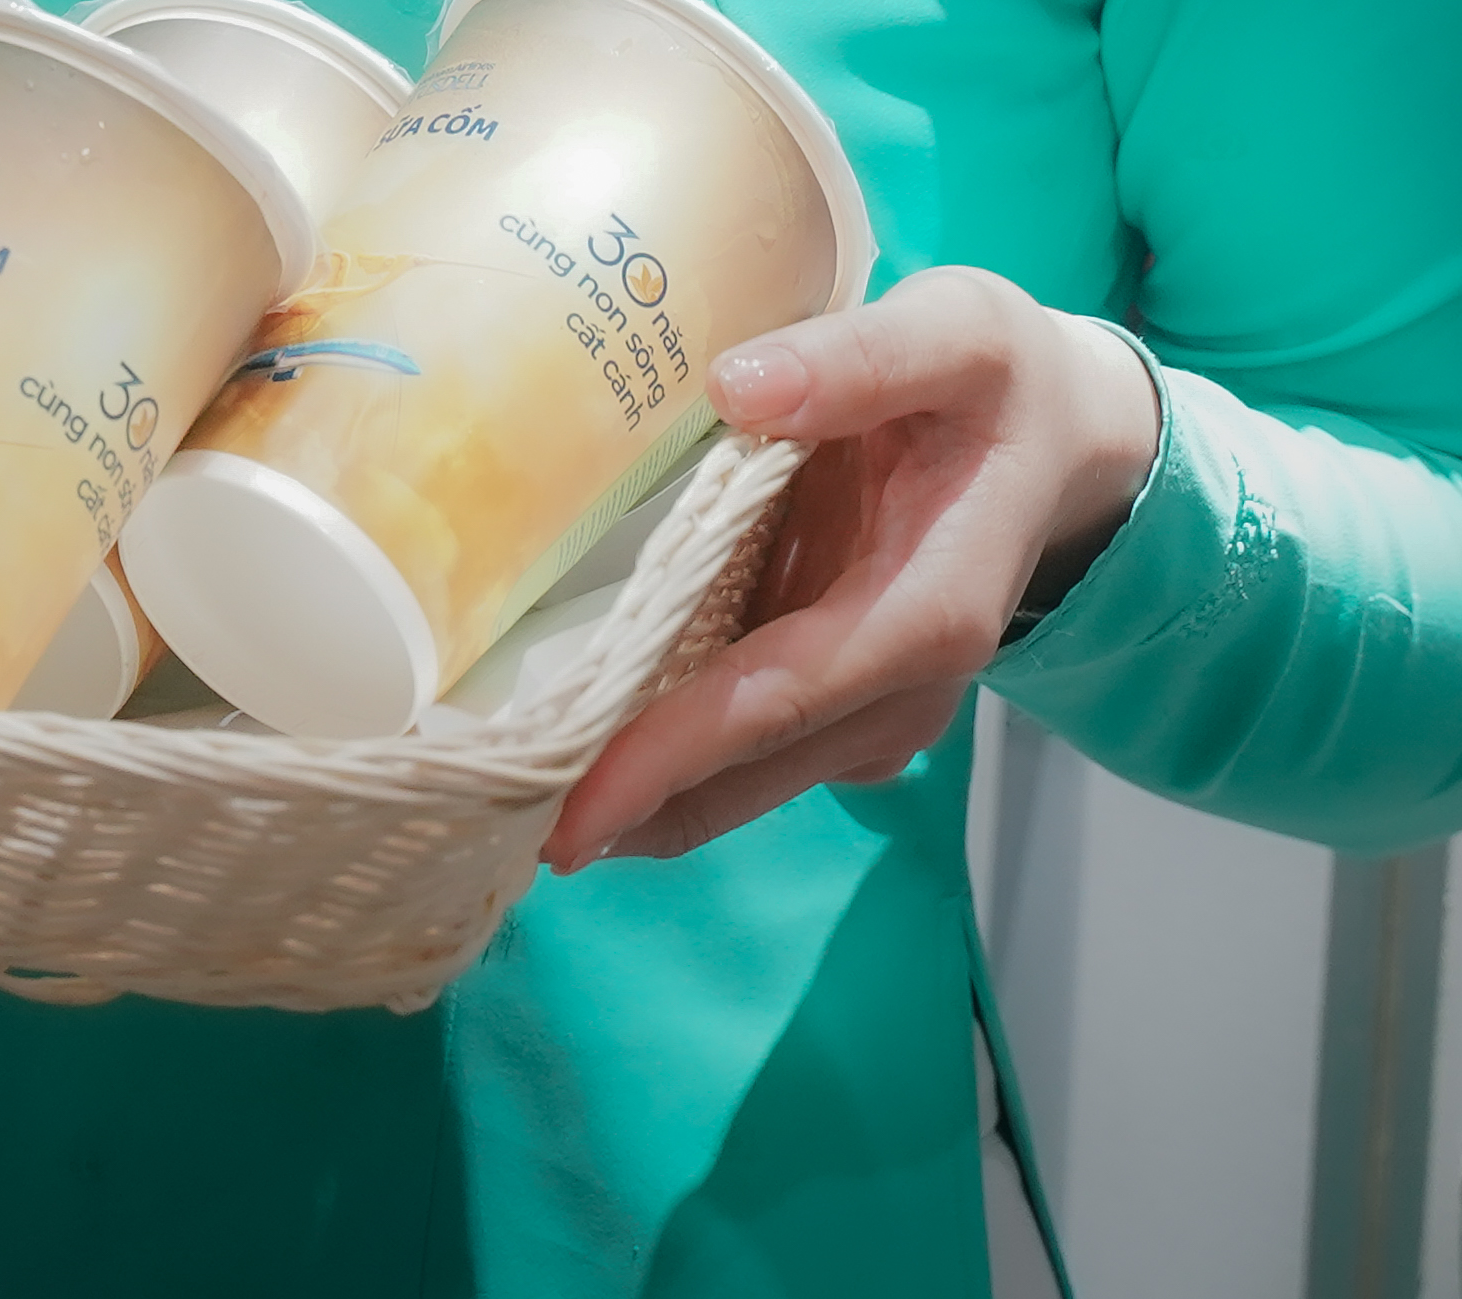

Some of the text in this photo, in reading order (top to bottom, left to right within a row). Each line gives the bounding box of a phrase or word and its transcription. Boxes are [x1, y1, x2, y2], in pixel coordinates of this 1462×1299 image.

[426, 104, 500, 142] CỐM
[499, 213, 666, 410] cùng non sông
[587, 212, 690, 384] 30 năm
[99, 360, 159, 452] 30
[565, 312, 644, 433] cất cánh
[19, 375, 89, 444] cùng
[88, 432, 124, 486] non
[76, 478, 107, 522] cất
